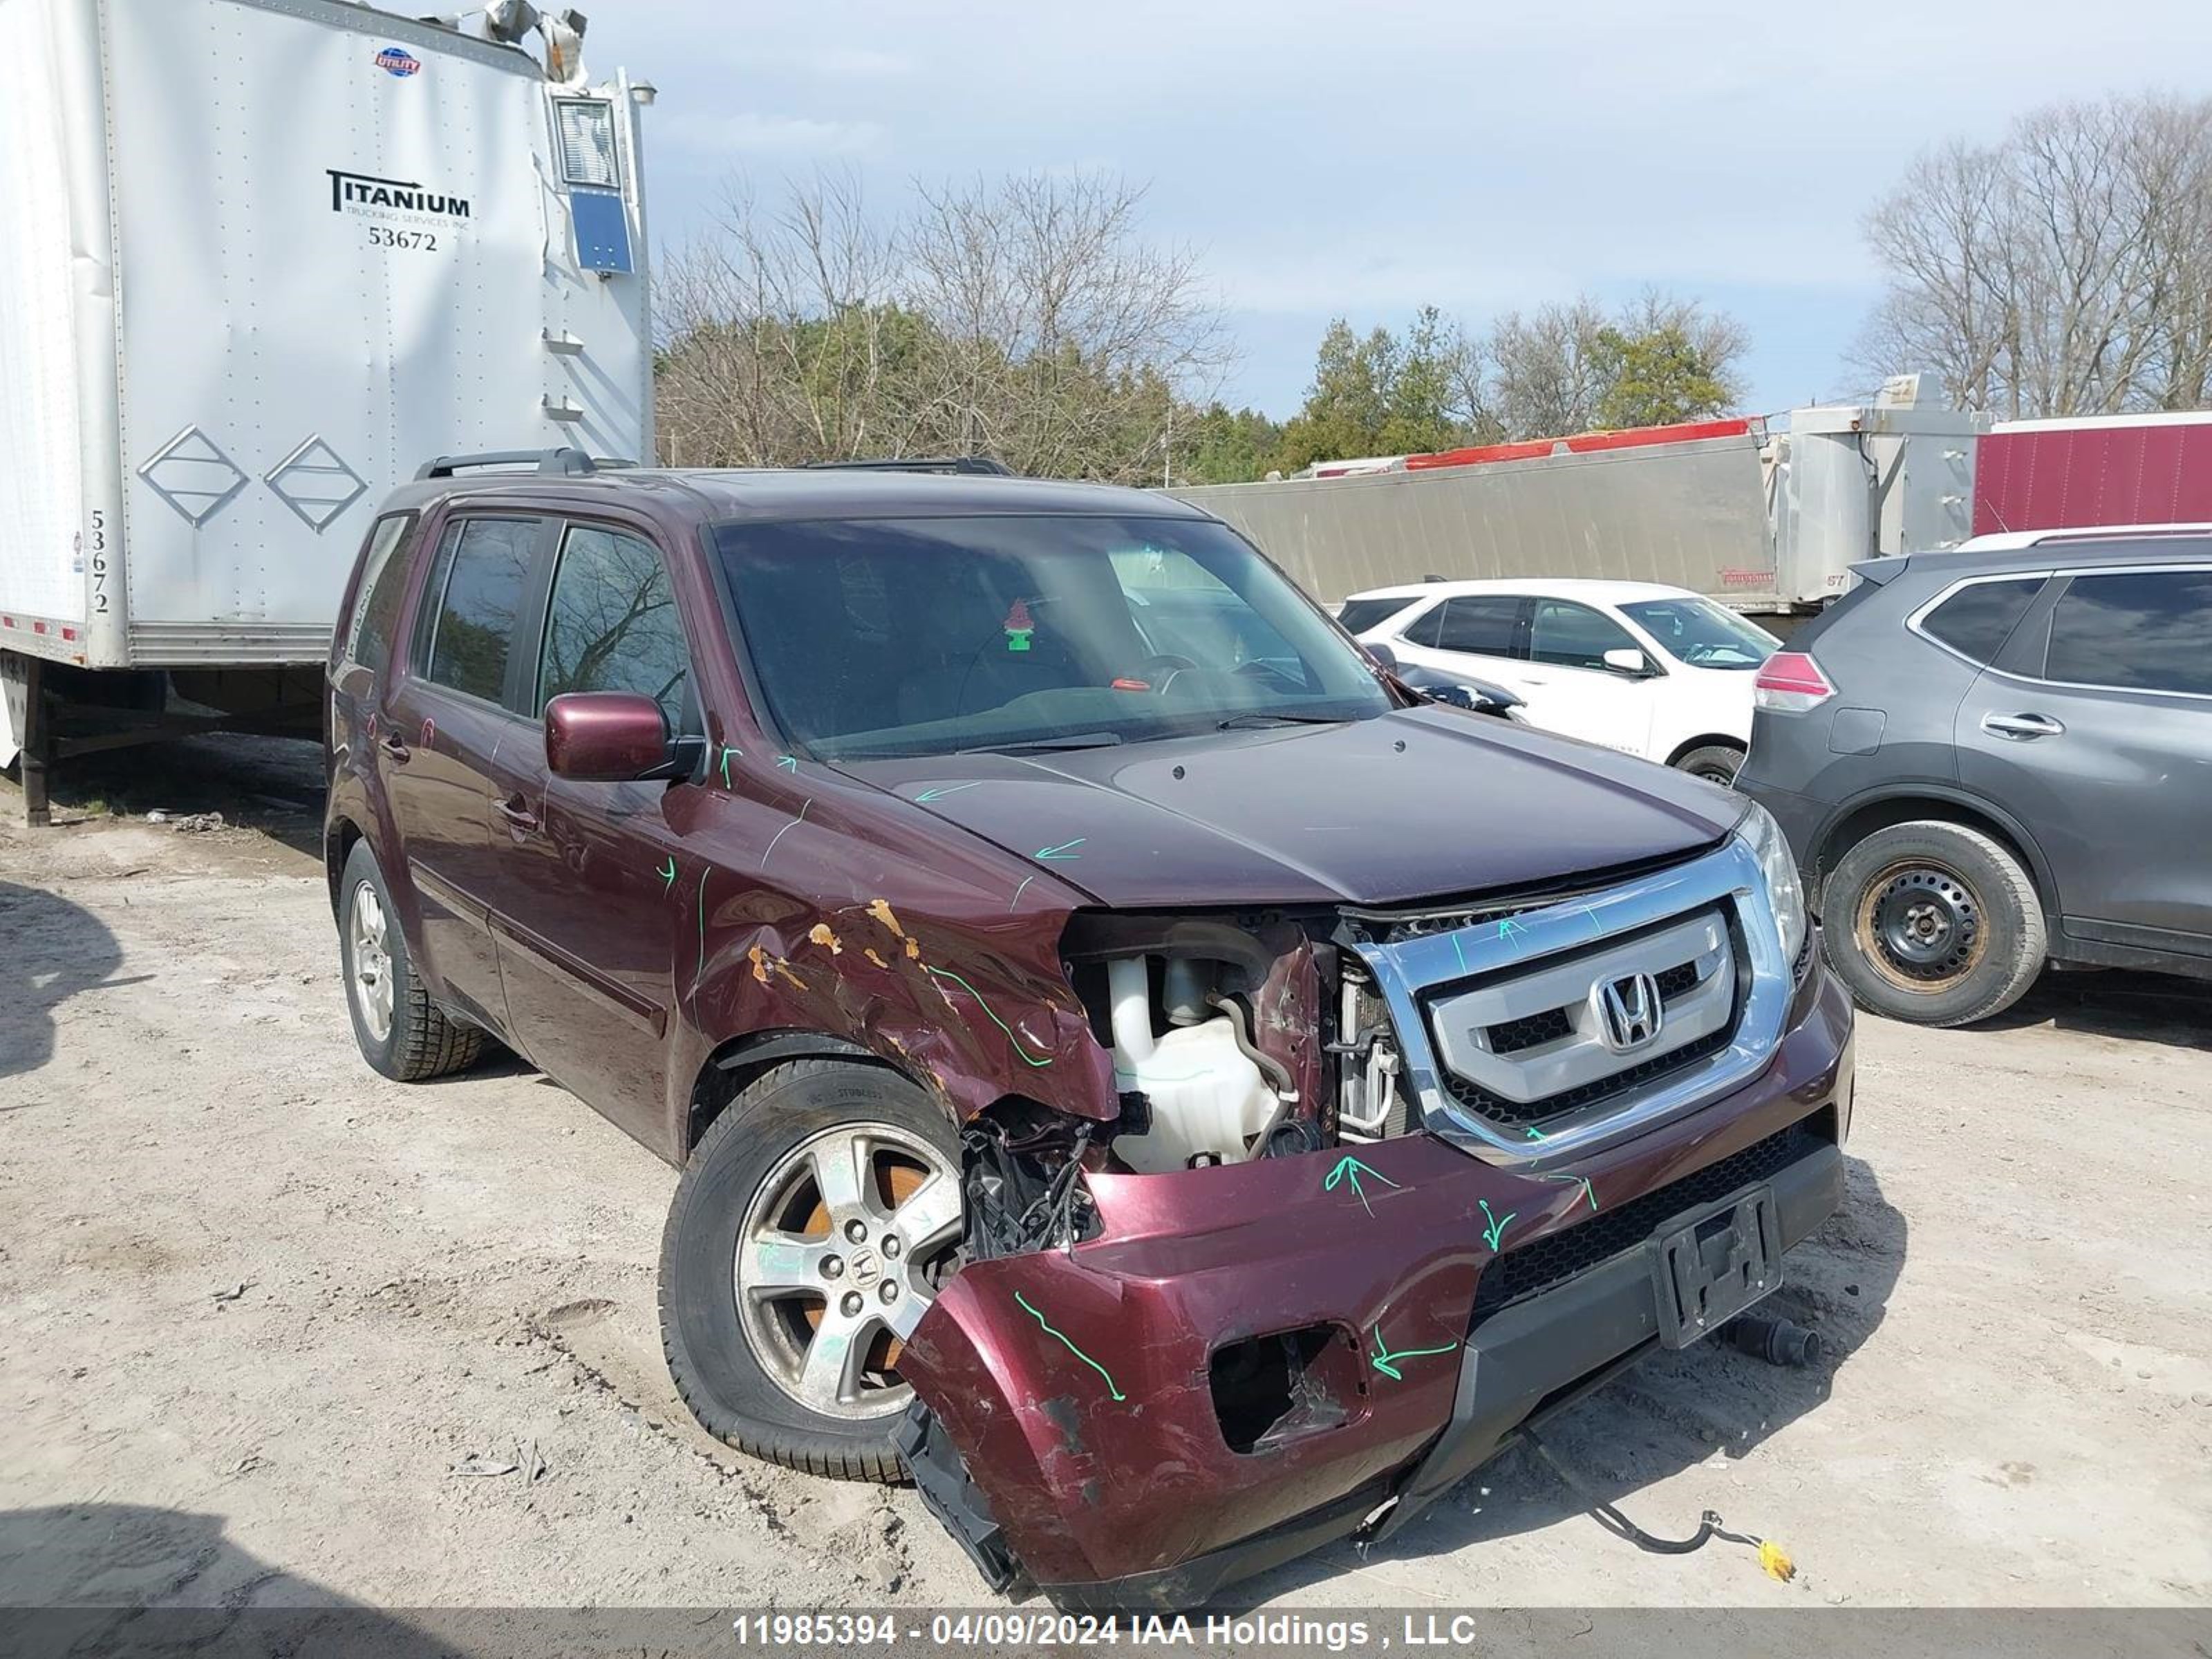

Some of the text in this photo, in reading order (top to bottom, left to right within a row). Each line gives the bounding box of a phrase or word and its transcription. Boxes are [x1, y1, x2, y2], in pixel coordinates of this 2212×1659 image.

[377, 57, 418, 70] UTILITY
[326, 169, 470, 218] TITANIUM
[368, 226, 437, 252] 53672
[92, 510, 108, 613] 53672
